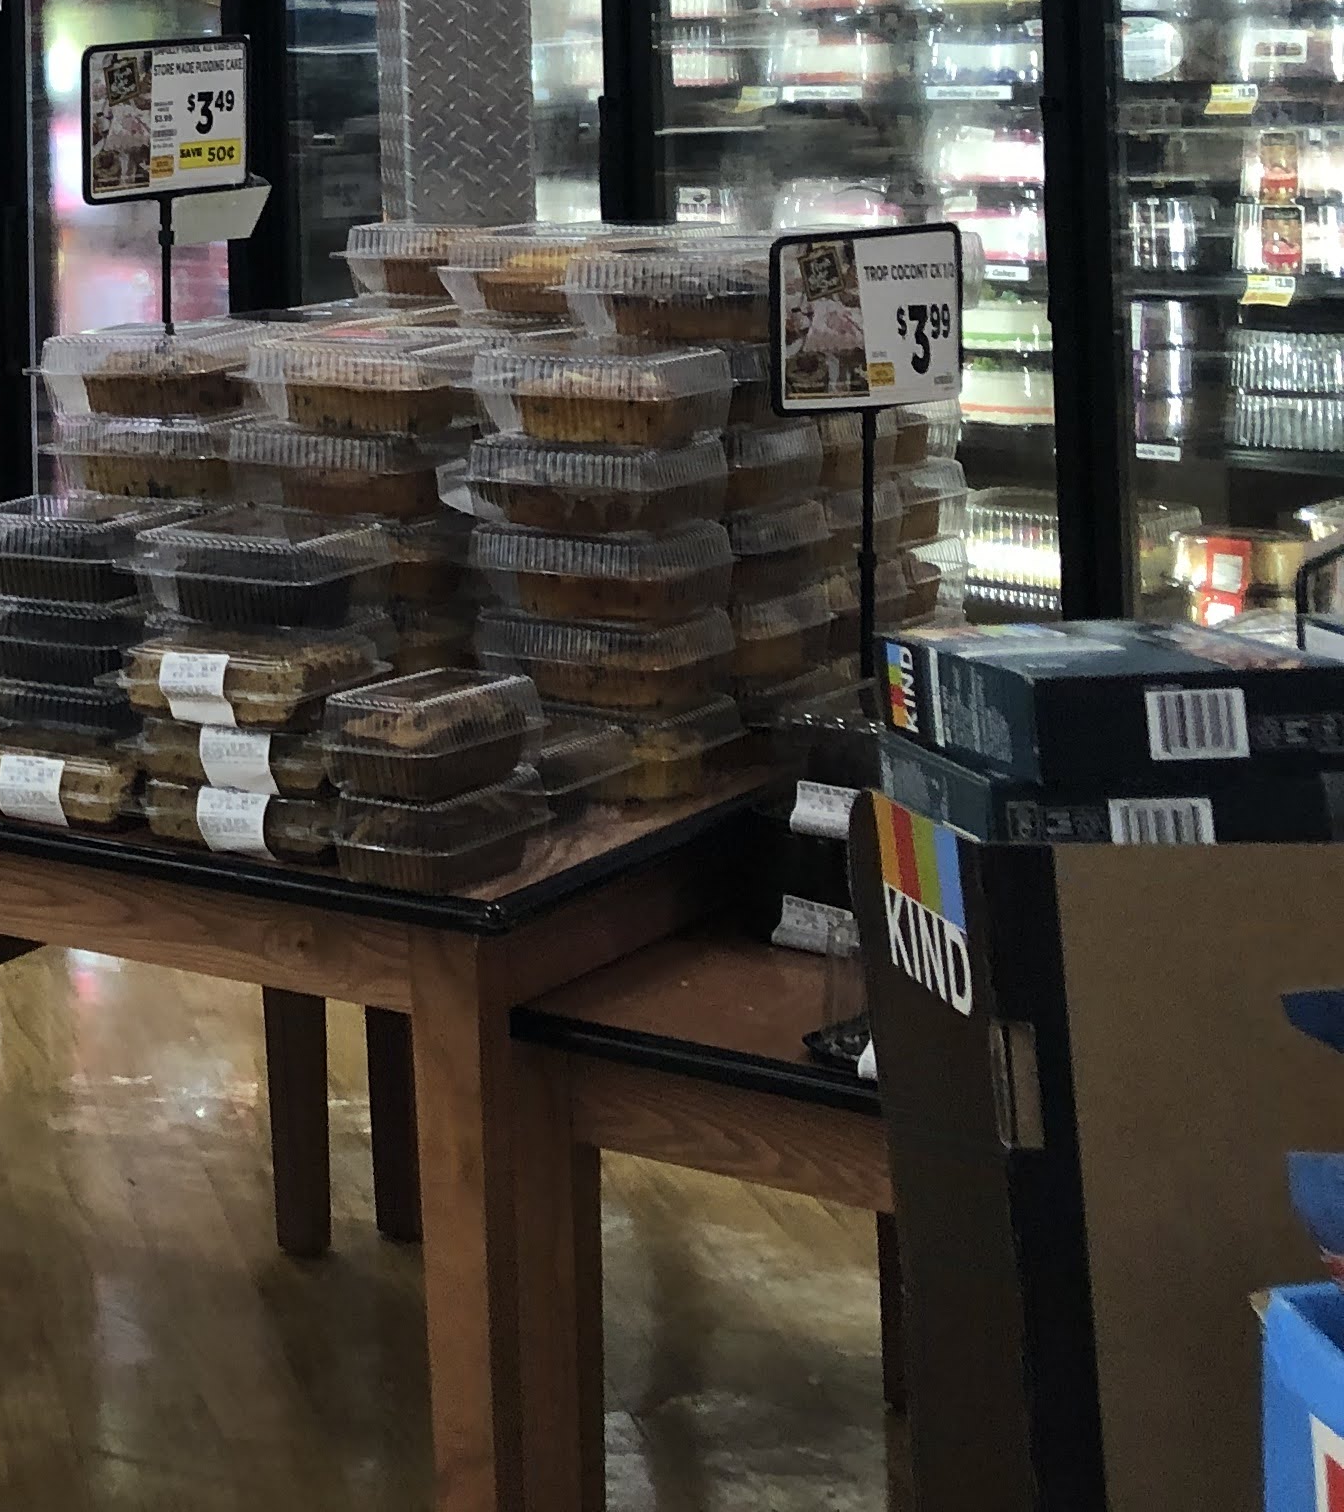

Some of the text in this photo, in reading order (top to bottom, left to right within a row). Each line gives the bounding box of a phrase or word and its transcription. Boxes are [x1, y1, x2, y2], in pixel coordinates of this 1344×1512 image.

[153, 62, 175, 76] STORE
[176, 61, 196, 75] MADE
[179, 145, 235, 162] SAVE 50¢
[864, 265, 888, 281] TROP
[898, 646, 920, 734] KIND
[882, 880, 974, 1016] KIND
